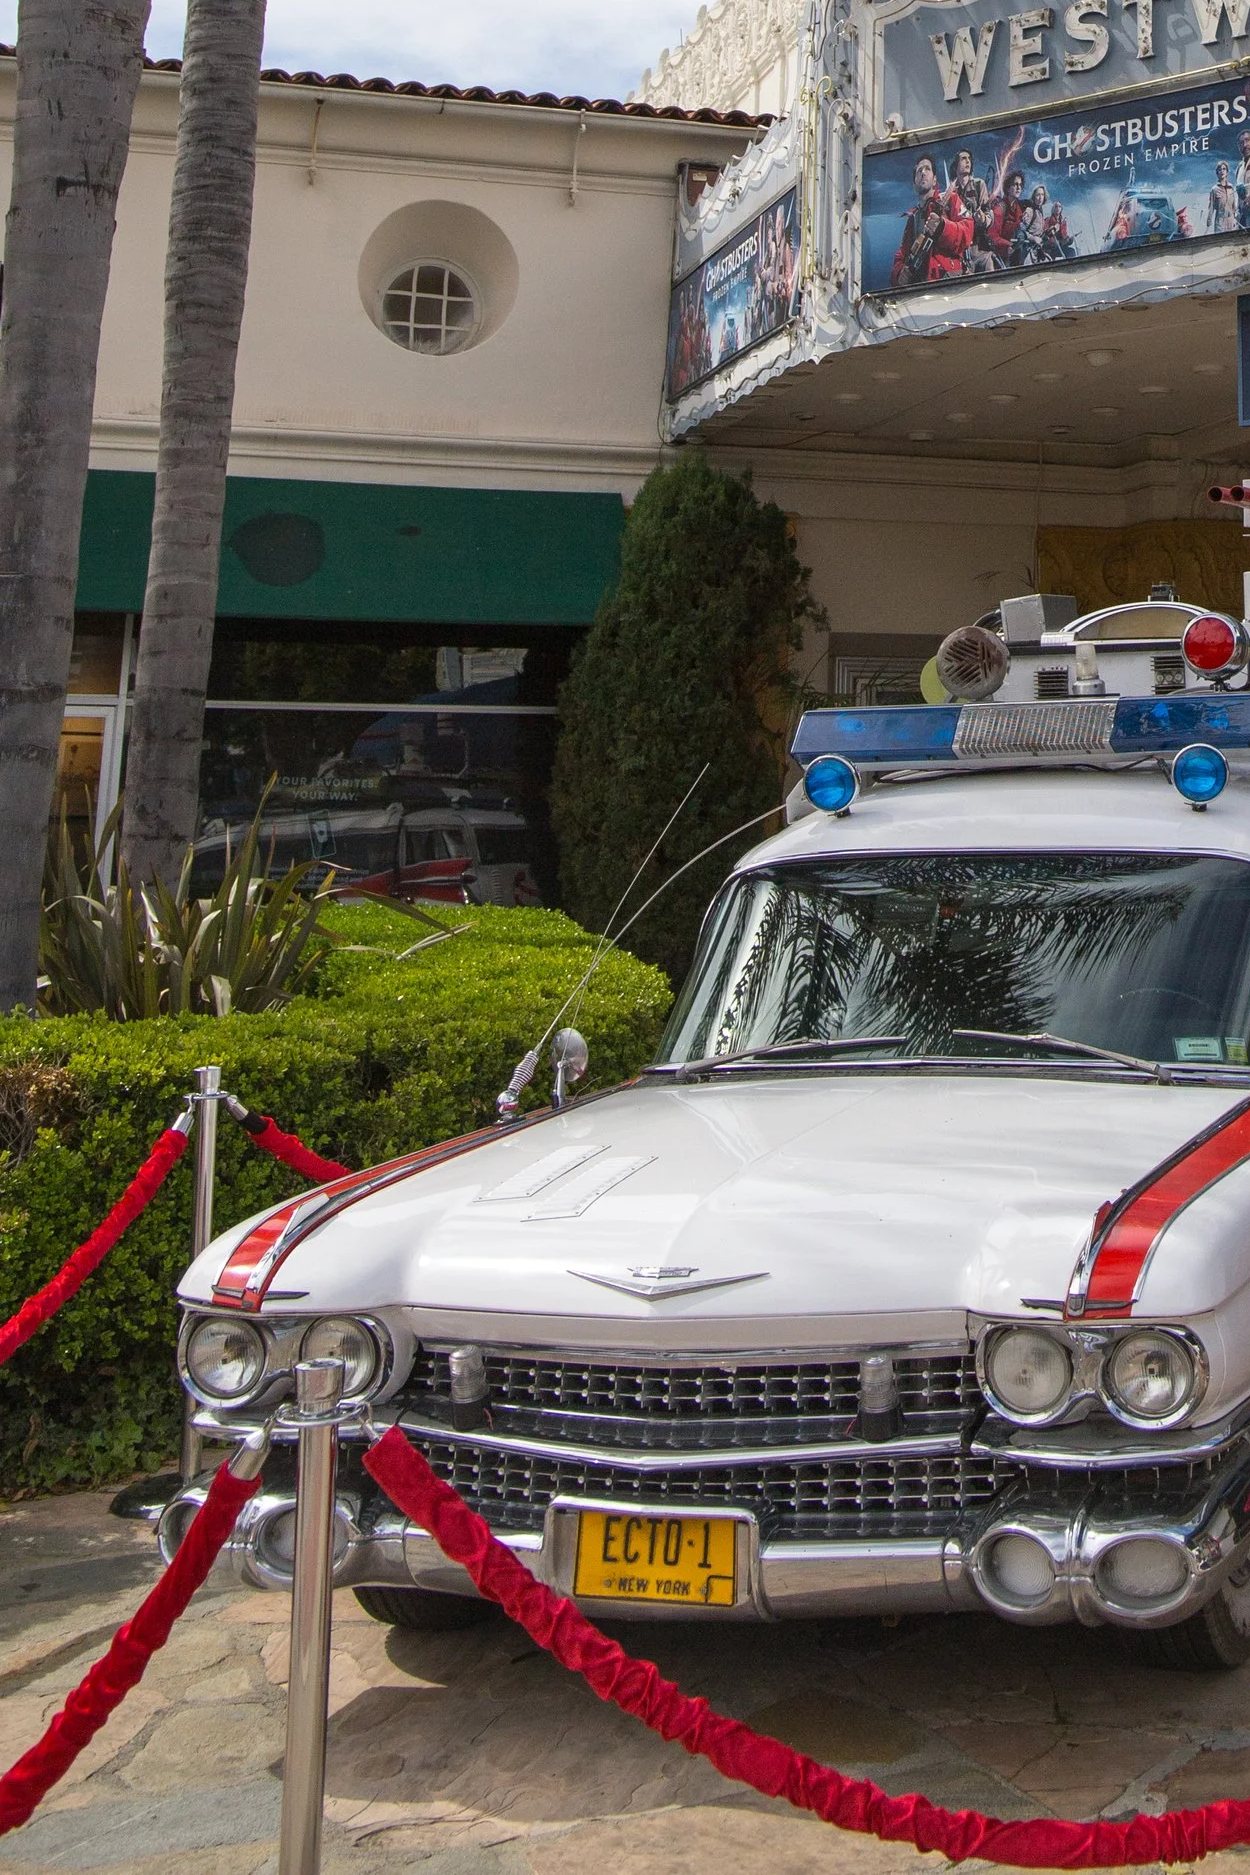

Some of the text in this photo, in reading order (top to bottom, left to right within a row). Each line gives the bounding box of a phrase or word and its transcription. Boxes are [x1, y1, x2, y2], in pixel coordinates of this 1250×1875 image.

[1068, 137, 1210, 177] FROZEN EMPIRE
[292, 790, 327, 800] YOUR
[617, 1577, 692, 1596] NEW YORK
